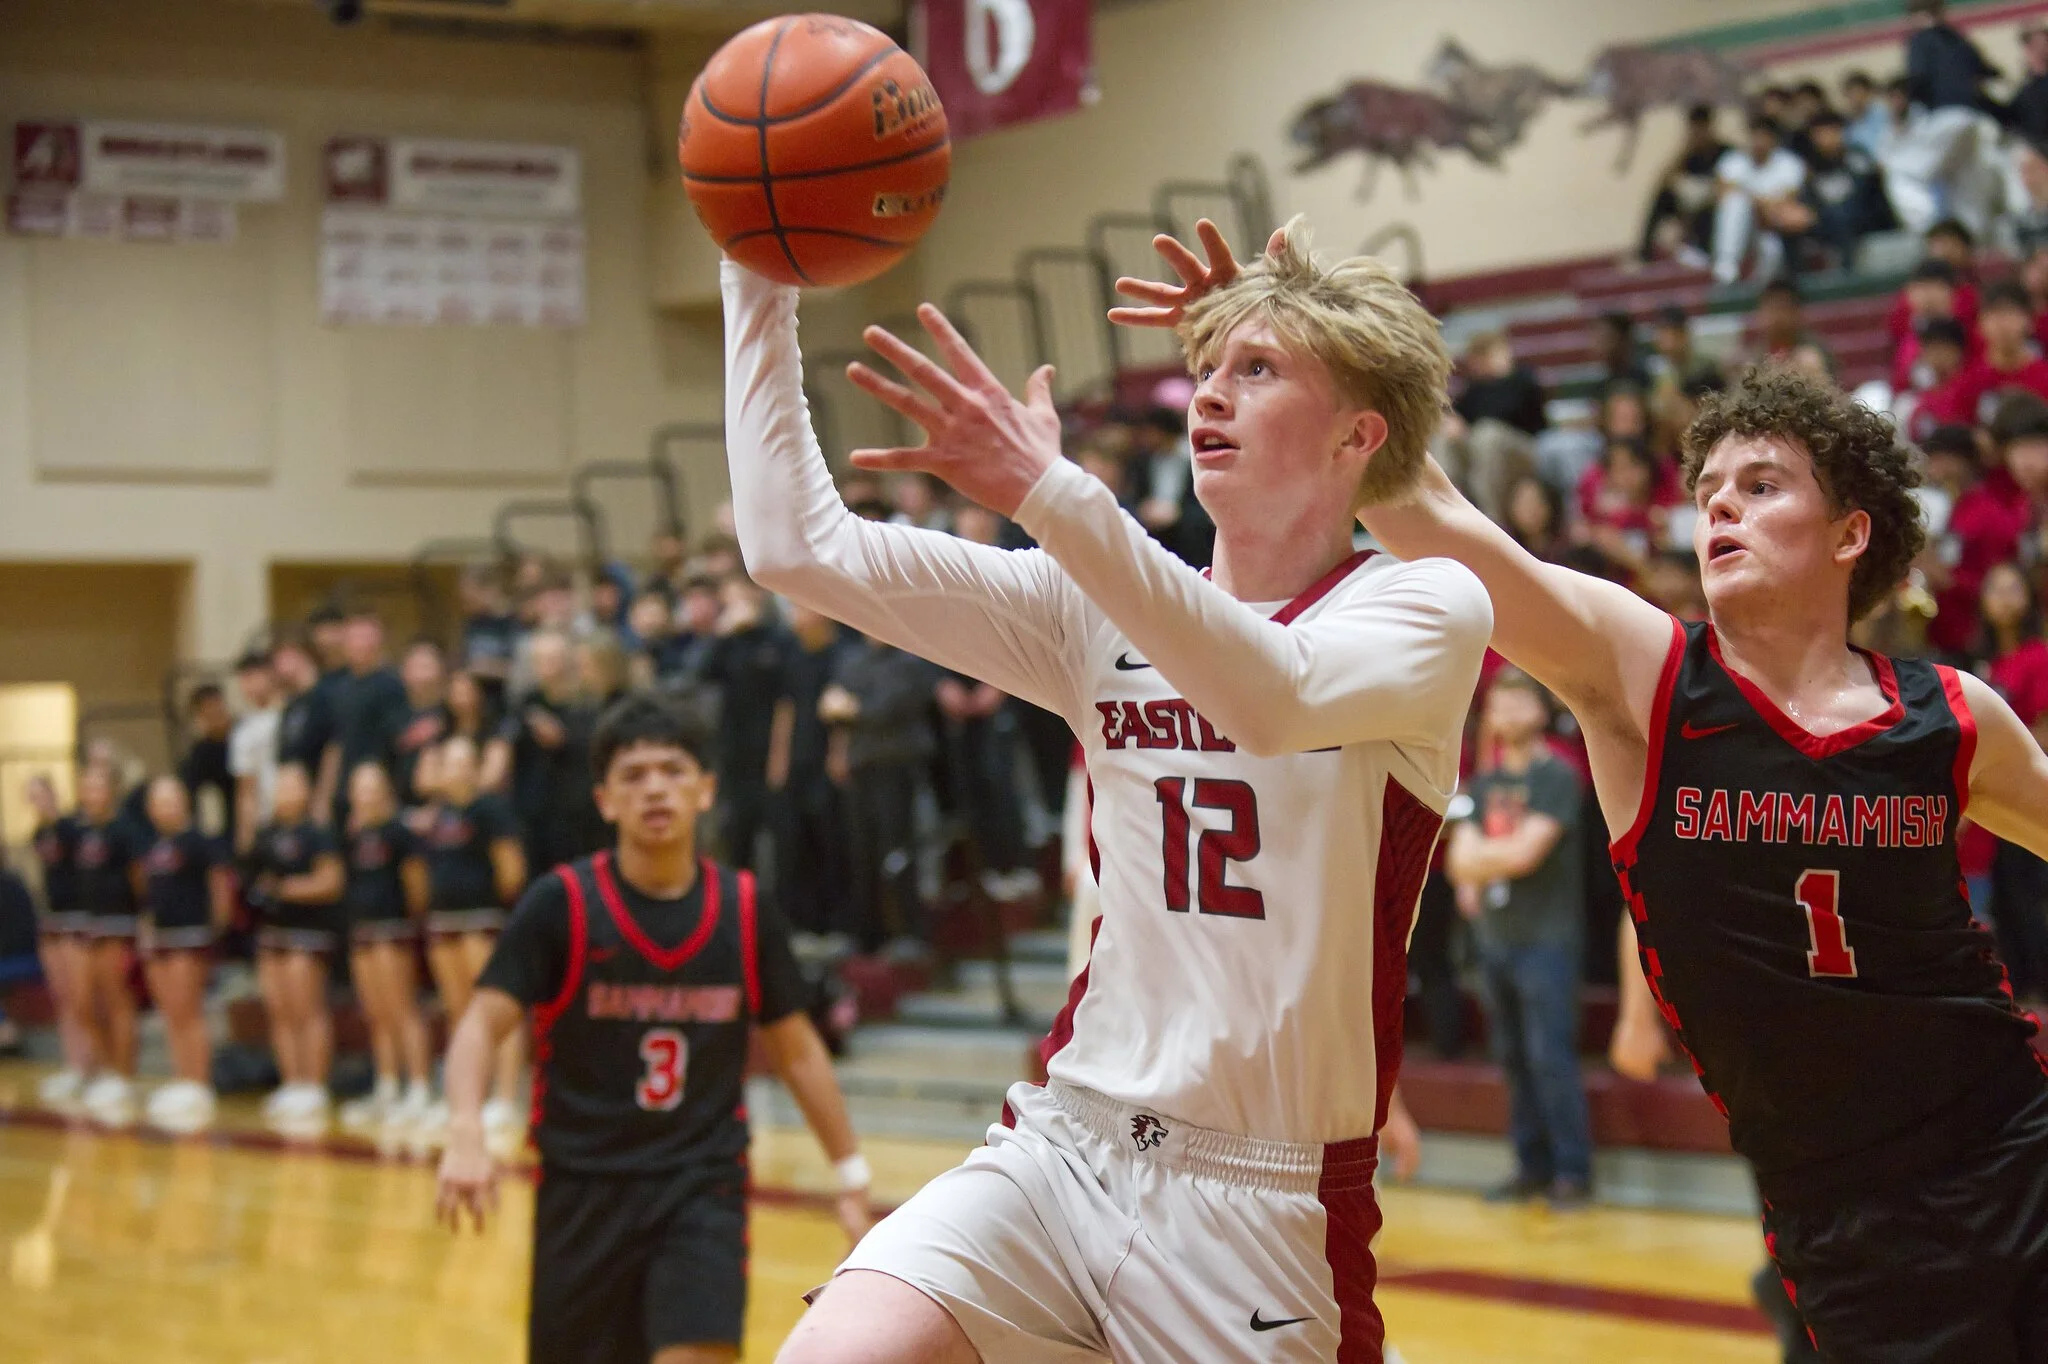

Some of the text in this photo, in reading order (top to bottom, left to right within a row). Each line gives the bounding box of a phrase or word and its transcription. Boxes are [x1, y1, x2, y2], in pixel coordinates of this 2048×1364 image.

[1095, 698, 1342, 753] EASTL
[1154, 776, 1266, 920] 12
[1675, 786, 1948, 848] SAMMAMISH
[1794, 868, 1858, 978] 1
[635, 1028, 689, 1112] 3
